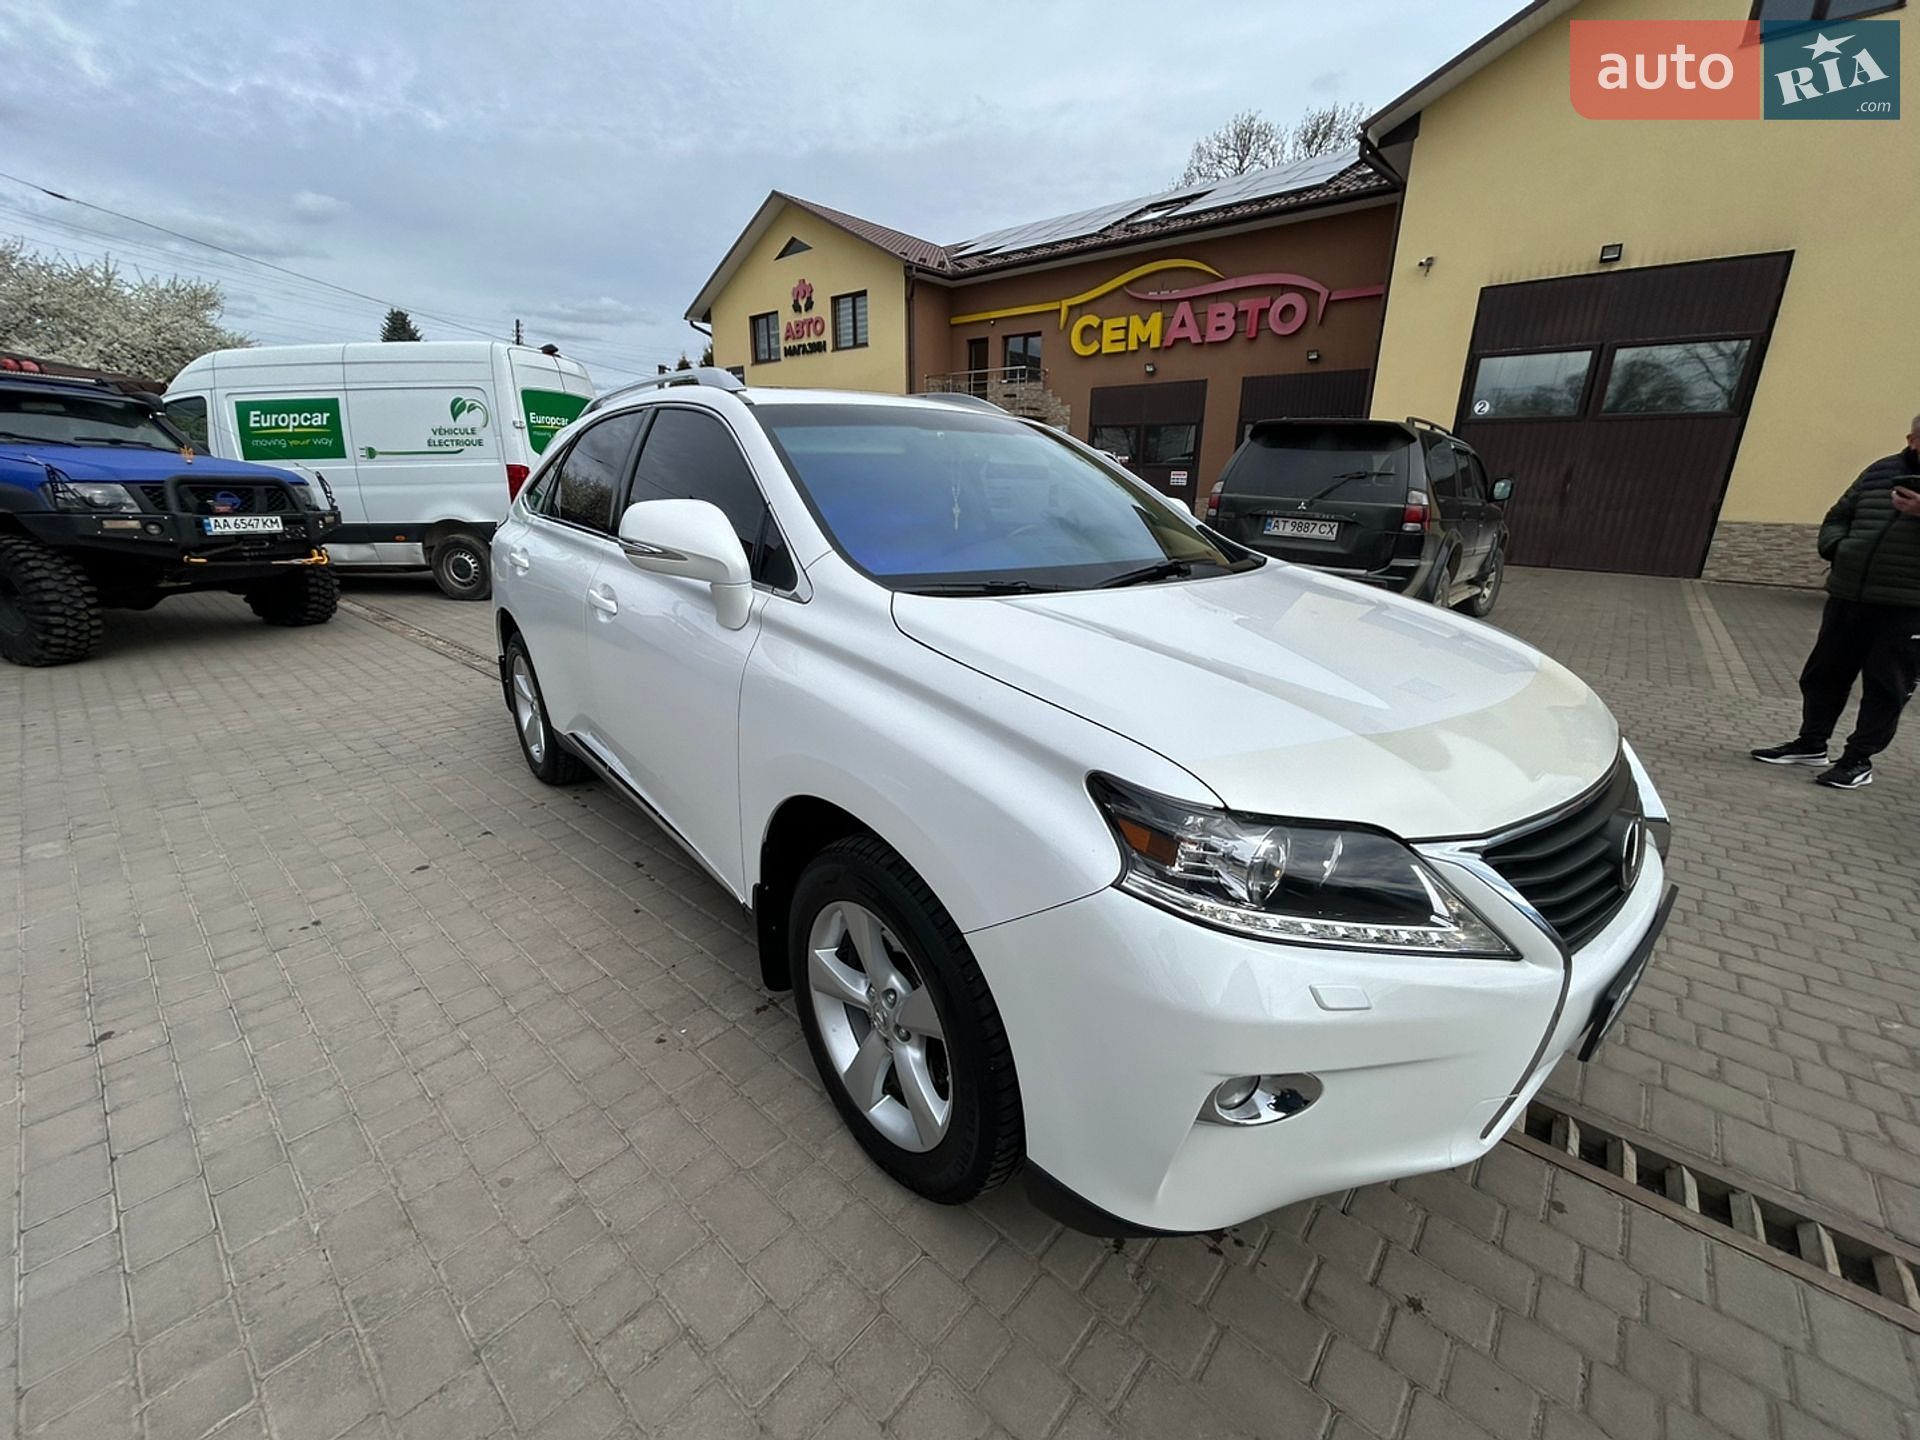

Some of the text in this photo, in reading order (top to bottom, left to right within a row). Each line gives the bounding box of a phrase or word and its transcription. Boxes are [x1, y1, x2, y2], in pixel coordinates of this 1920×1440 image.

[784, 315, 825, 341] АВТО
[249, 410, 331, 432] Europcar
[529, 412, 569, 428] Europcar
[431, 425, 477, 436] VÉHICULE
[251, 438, 287, 448] moving
[312, 437, 333, 447] way
[427, 437, 484, 447] ÉLECTRIQUE
[214, 518, 280, 530] AA 6547 KM
[1271, 520, 1336, 535] AT 9887 CX
